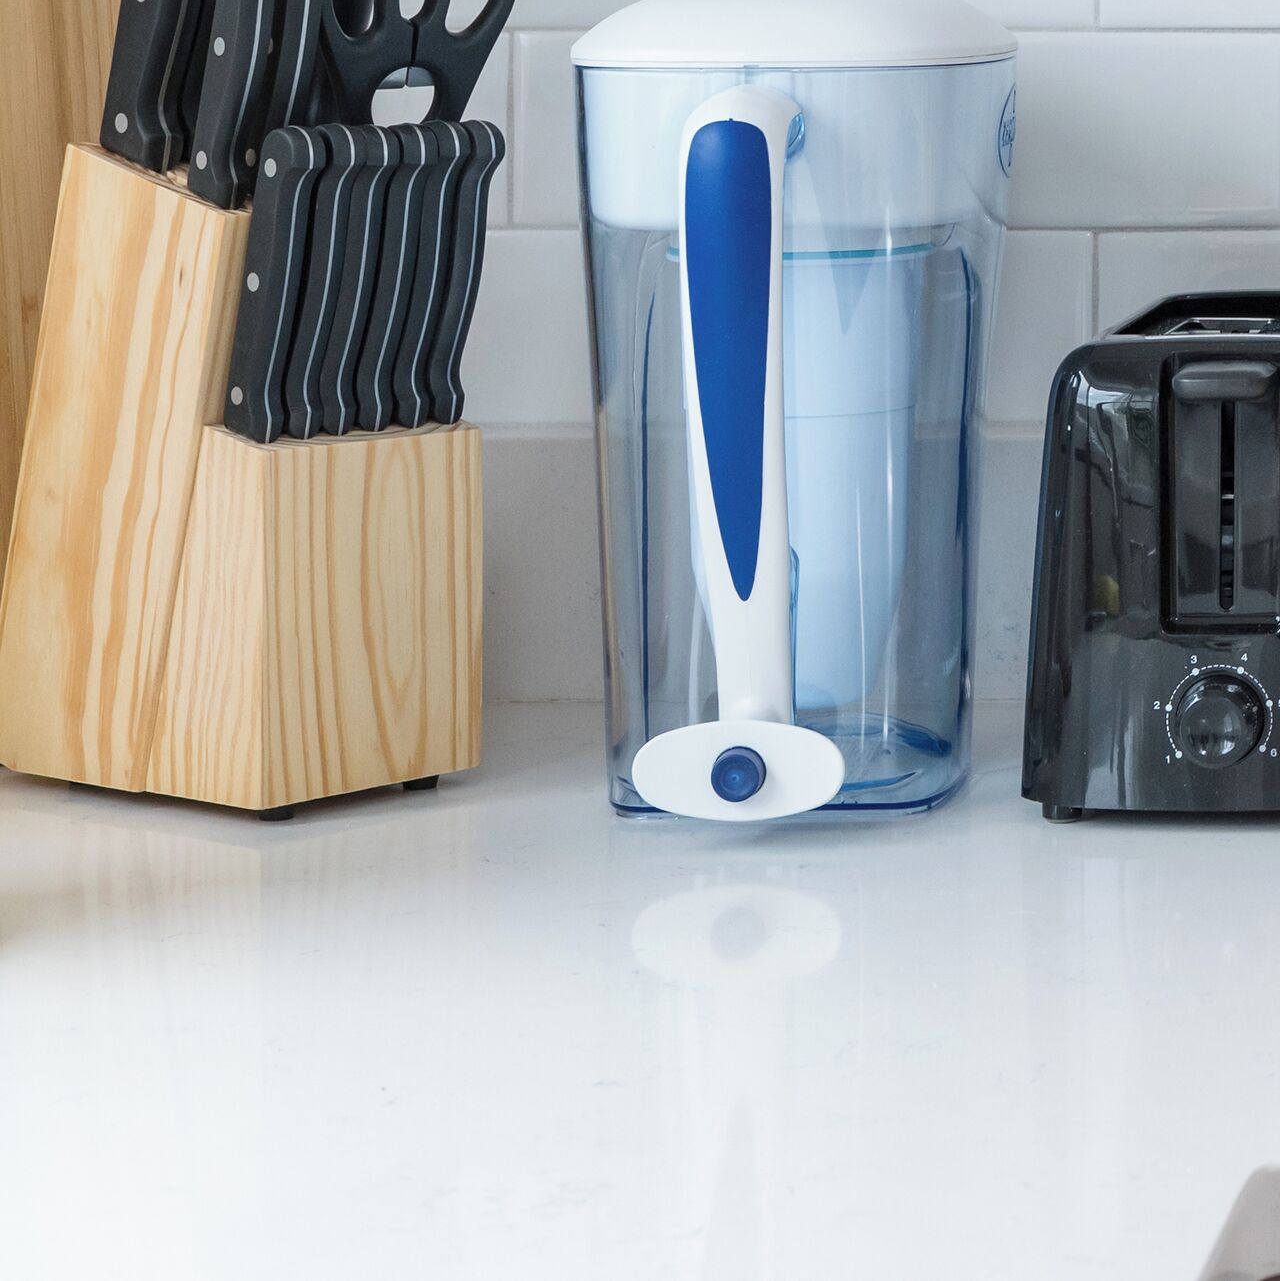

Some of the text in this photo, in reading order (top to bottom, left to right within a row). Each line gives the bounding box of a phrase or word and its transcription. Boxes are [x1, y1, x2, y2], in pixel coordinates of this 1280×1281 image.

[1190, 655, 1198, 664] 3
[1240, 653, 1248, 662] 4
[1153, 701, 1161, 710] 2
[1270, 748, 1278, 758] 6
